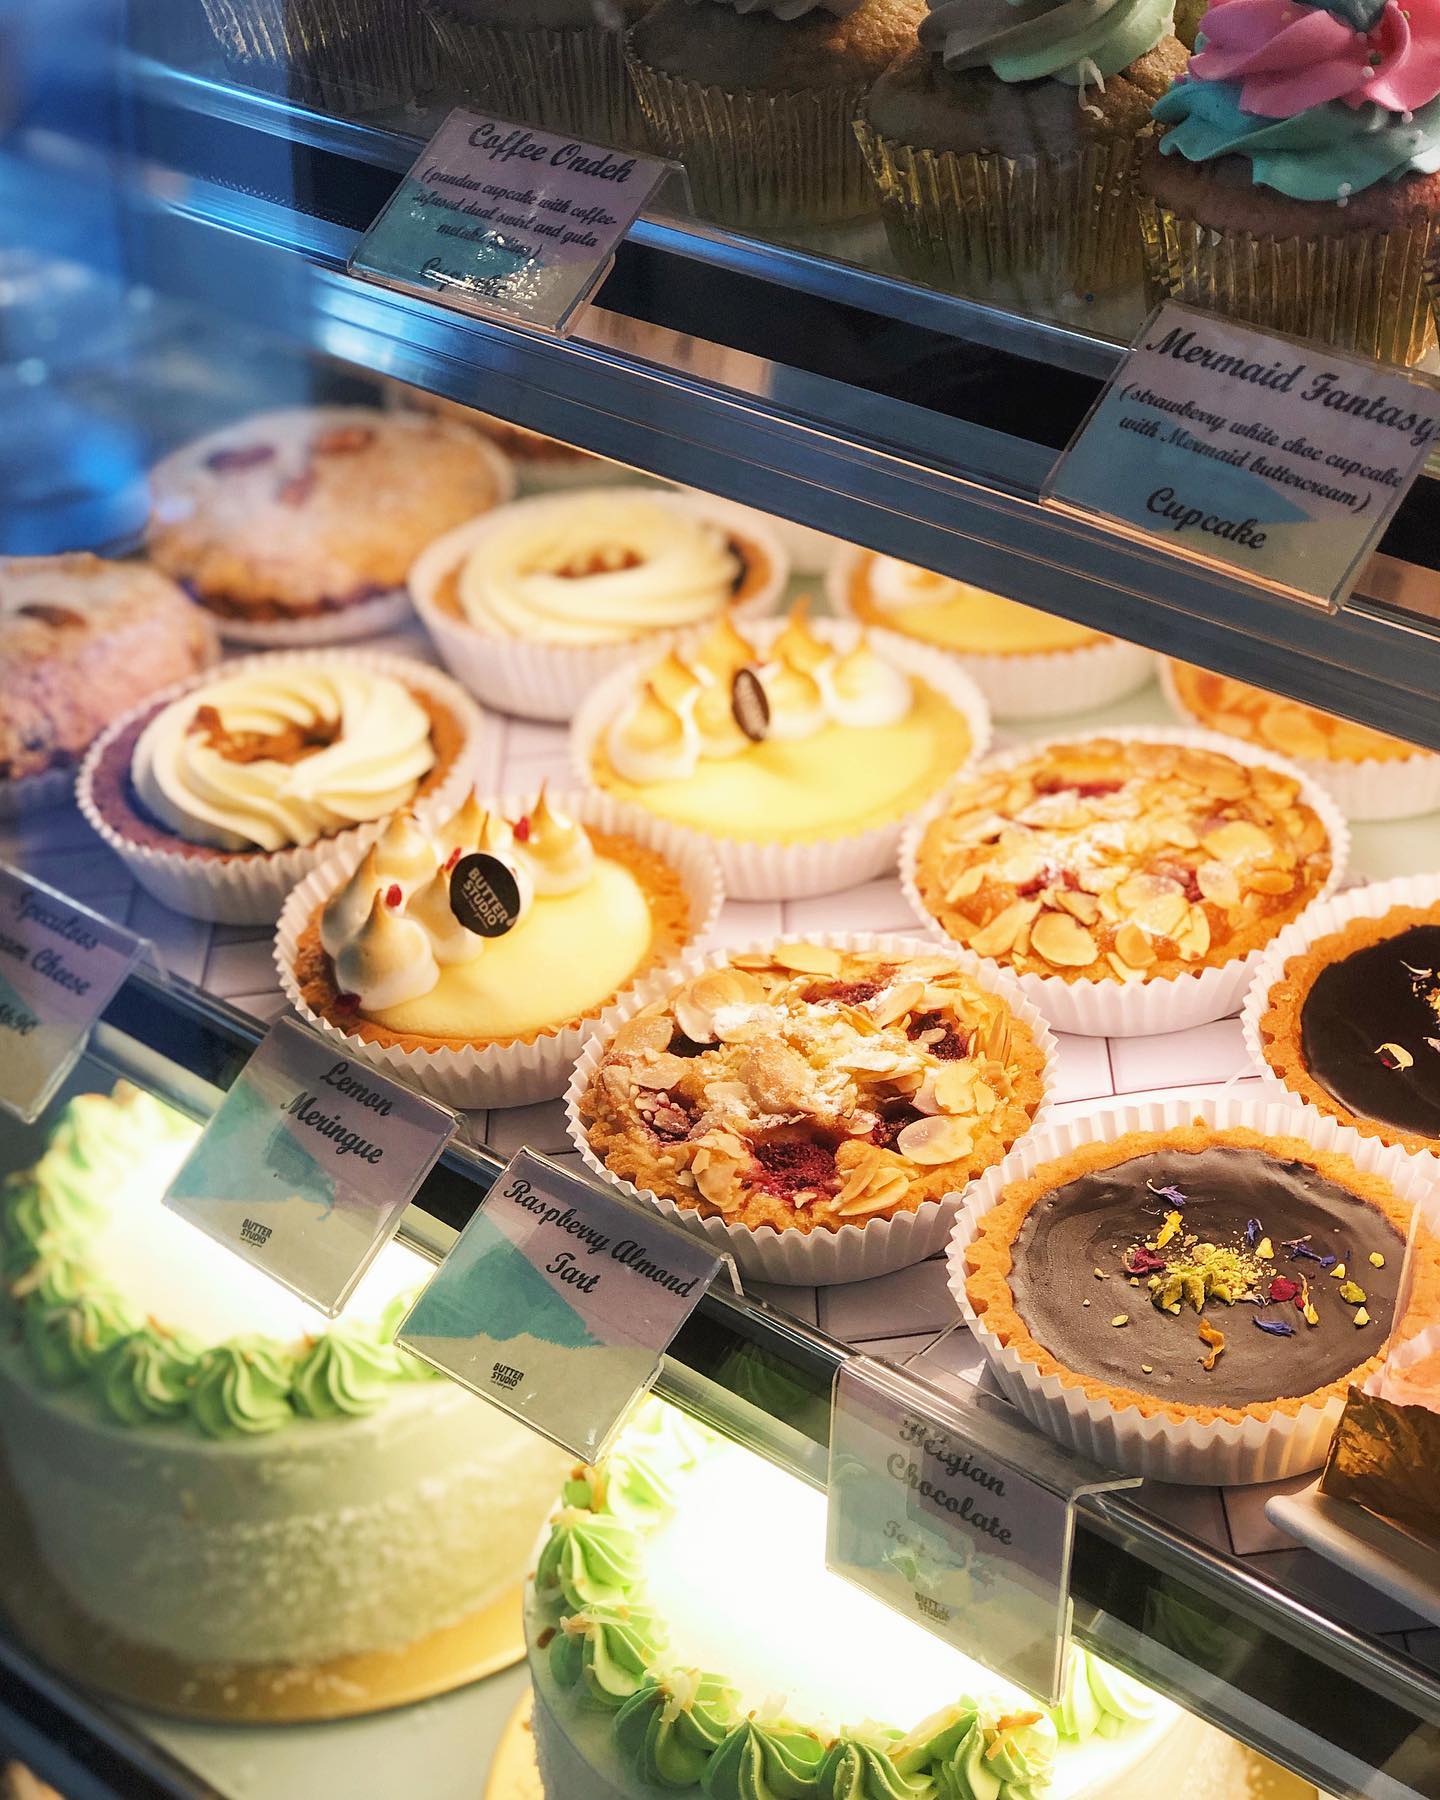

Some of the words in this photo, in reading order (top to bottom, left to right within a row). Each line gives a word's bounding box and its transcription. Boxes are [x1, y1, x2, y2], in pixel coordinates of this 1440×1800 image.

[468, 123, 548, 162] Coffee
[550, 143, 638, 183] Ondeh
[463, 198, 498, 221] dual
[496, 213, 537, 231] swirl
[534, 223, 565, 239] and
[561, 230, 600, 248] gula
[481, 182, 538, 204] cupcake
[538, 196, 571, 214] with
[1146, 327, 1306, 393] Mermaid
[1300, 372, 1436, 447] Fantasy
[1119, 414, 1158, 440] with
[1160, 422, 1252, 469] Mermaid
[1228, 421, 1280, 447] white
[1281, 434, 1323, 462] choc
[1324, 452, 1404, 488] cupcake
[1146, 486, 1268, 550] Cupcake
[463, 880, 497, 926] STUDIO
[468, 867, 508, 924] BUTTER
[320, 1061, 394, 1117] Lemon
[280, 1090, 385, 1165] Meringue
[240, 1228, 267, 1244] STUDIO
[242, 1218, 273, 1239] BUTTER
[503, 1179, 611, 1254] Raspberry
[610, 1239, 701, 1298] Almond
[545, 1251, 601, 1294] Tart
[491, 1371, 518, 1387] STUDIO
[493, 1362, 525, 1381] BUTTER
[887, 1453, 1012, 1545] Chocolate
